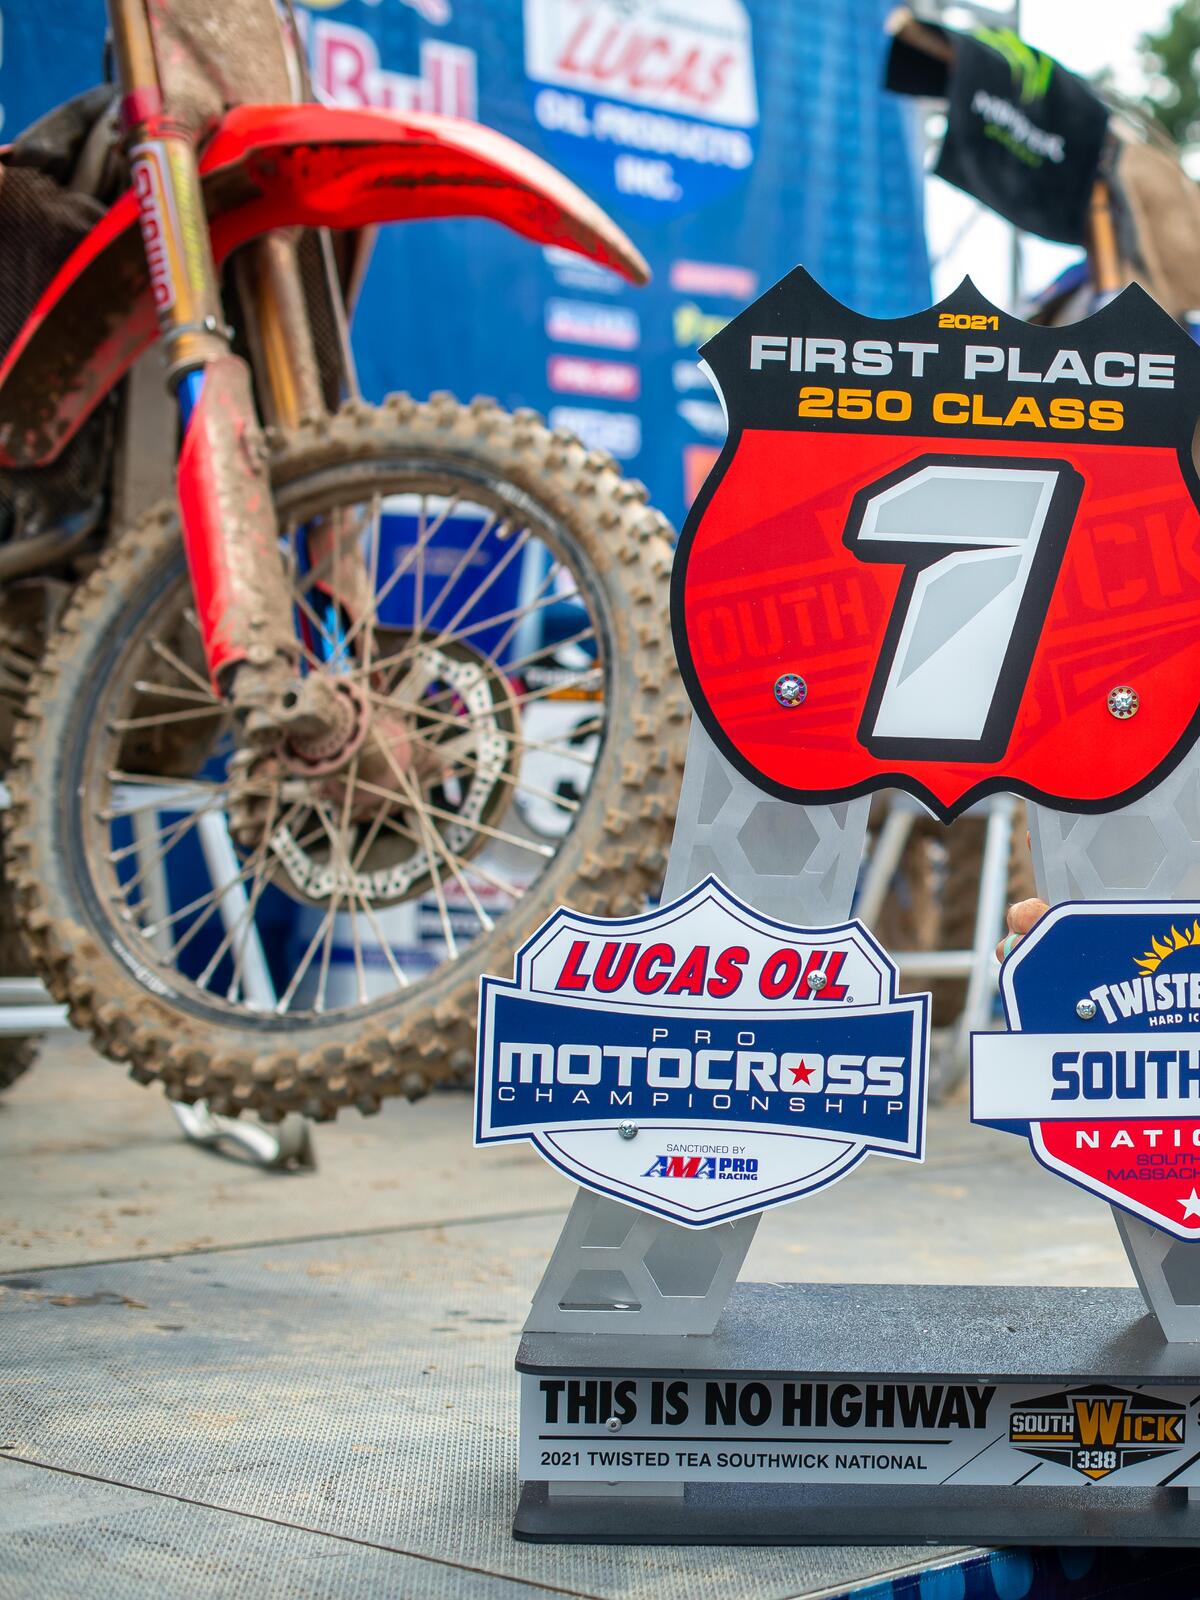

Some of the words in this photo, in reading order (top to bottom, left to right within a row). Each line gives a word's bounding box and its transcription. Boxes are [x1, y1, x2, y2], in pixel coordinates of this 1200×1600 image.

[557, 16, 737, 102] LUCAS
[535, 89, 592, 137] OIL
[938, 312, 1000, 331] 2021
[749, 335, 939, 378] FIRST
[963, 345, 1176, 389] PLACE
[797, 386, 912, 423] 250
[932, 393, 1125, 432] CLASS
[698, 567, 871, 665] OUTH
[554, 940, 749, 1000] LUCAS
[758, 947, 851, 1003] OIL
[1148, 1013, 1184, 1027] HARD
[651, 1028, 756, 1046] PRO
[498, 1041, 906, 1096] MOTOCROSS
[497, 1086, 904, 1115] CHAMPIONSHIP
[666, 1143, 729, 1154] SANCTIONED
[732, 1145, 746, 1155] BY
[639, 1155, 717, 1180] AMA
[718, 1157, 759, 1173] PRO
[718, 1172, 758, 1181] RACING
[539, 1379, 638, 1426] THIS
[650, 1380, 689, 1426] IS
[704, 1381, 772, 1427] NO
[781, 1383, 997, 1430] HIGHWAY
[540, 1450, 581, 1467] 2021
[587, 1451, 670, 1467] TWISTED
[675, 1452, 711, 1468] TEA
[716, 1452, 829, 1469] SOUTHWICK
[834, 1454, 928, 1470] NATIONAL
[1076, 1450, 1117, 1470] 338
